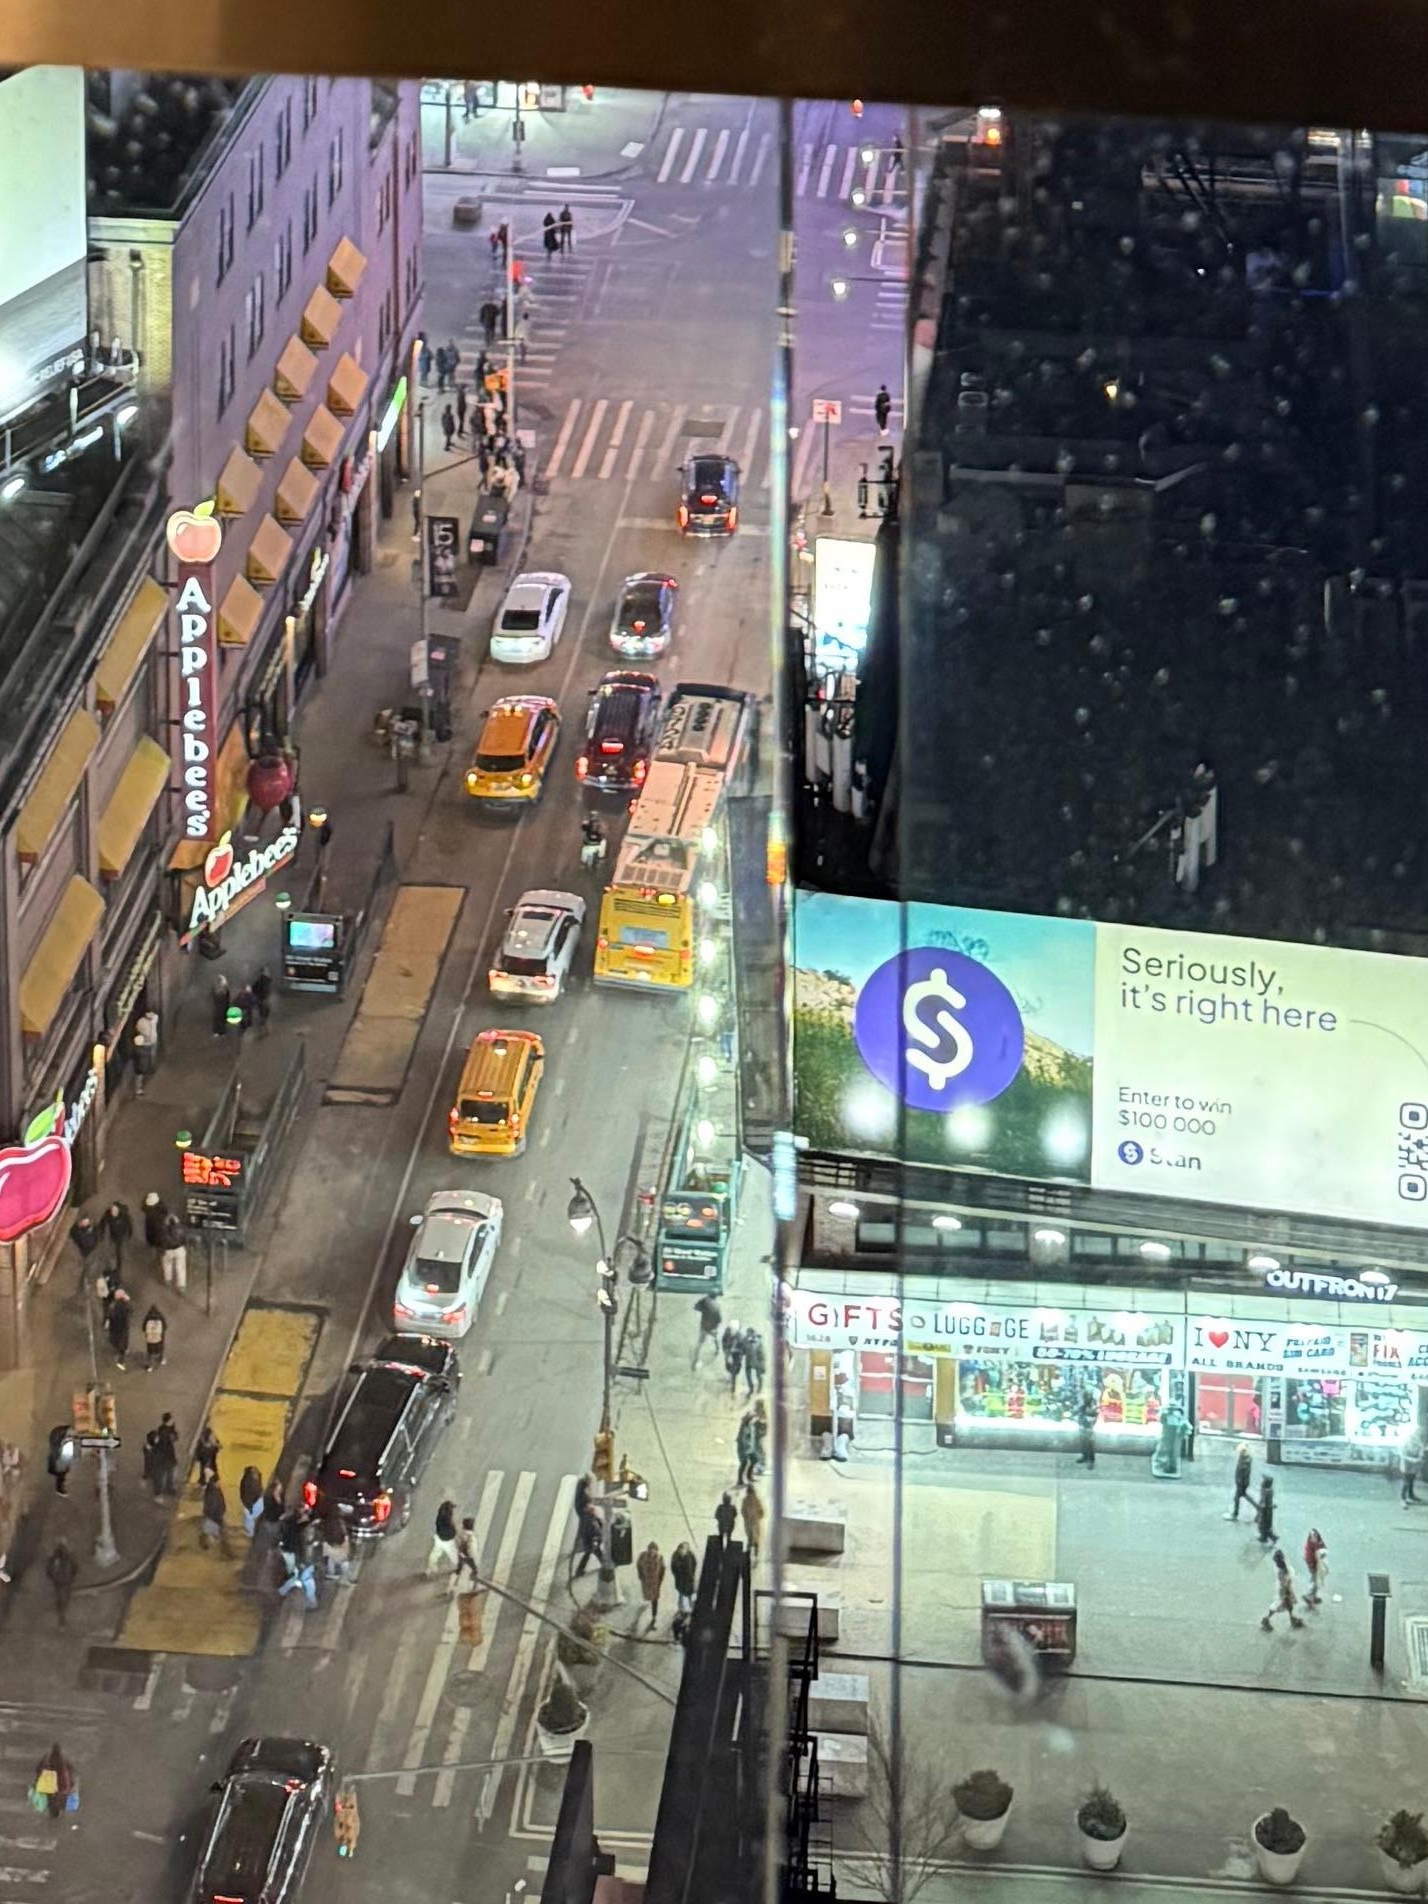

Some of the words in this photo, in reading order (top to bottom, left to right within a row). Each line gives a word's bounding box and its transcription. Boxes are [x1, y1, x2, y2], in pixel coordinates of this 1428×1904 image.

[1122, 947, 1284, 996] Seriously,
[1121, 981, 1167, 1012] it's
[1176, 990, 1254, 1025] right
[1262, 998, 1338, 1032] here
[1118, 1086, 1170, 1108] Enter
[1174, 1095, 1195, 1111] to
[1198, 1097, 1233, 1115] win
[1118, 1109, 1217, 1136] $100000
[1150, 1147, 1202, 1171] San
[808, 1302, 904, 1332] GIFTS
[934, 1313, 1030, 1339] LUGGGE
[1232, 1330, 1277, 1353] NY
[1191, 1356, 1217, 1368] ALL
[1226, 1360, 1285, 1372] BRANDS
